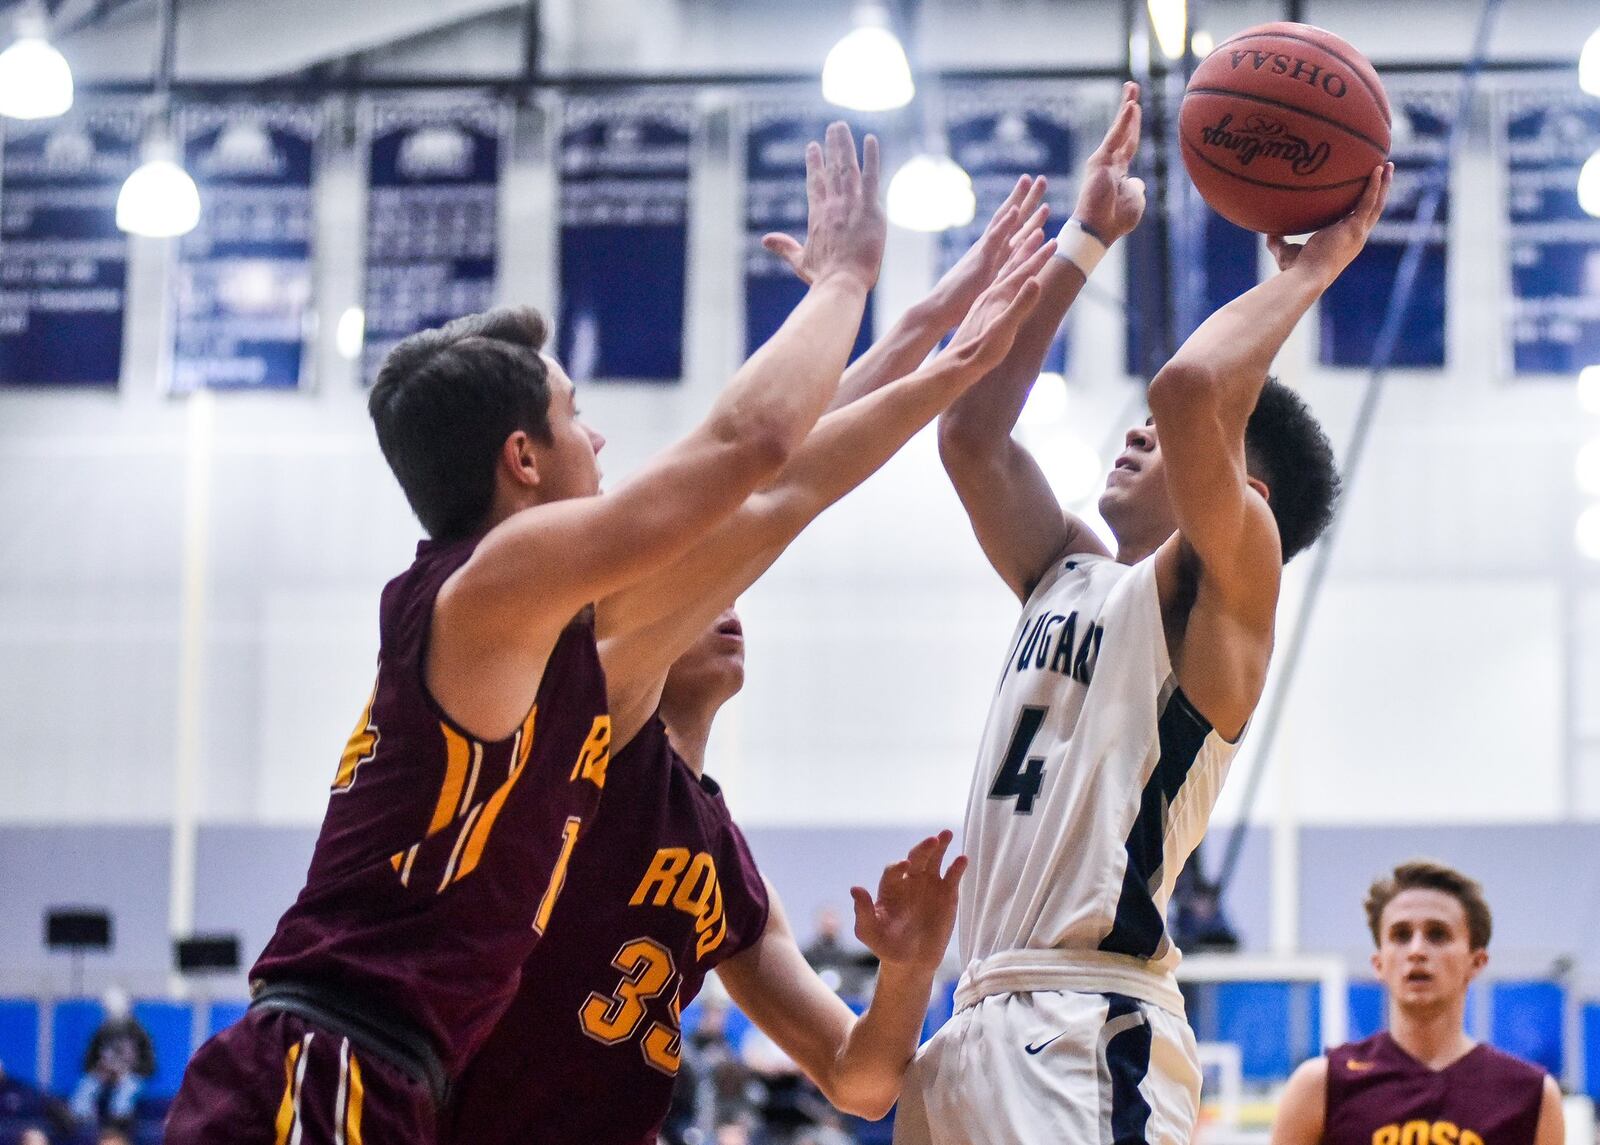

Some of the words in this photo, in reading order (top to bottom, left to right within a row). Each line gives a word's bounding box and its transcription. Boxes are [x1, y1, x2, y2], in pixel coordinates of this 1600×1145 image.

[1230, 50, 1347, 98] OHSAA
[1202, 113, 1331, 176] Rawlings
[987, 704, 1050, 816] 4
